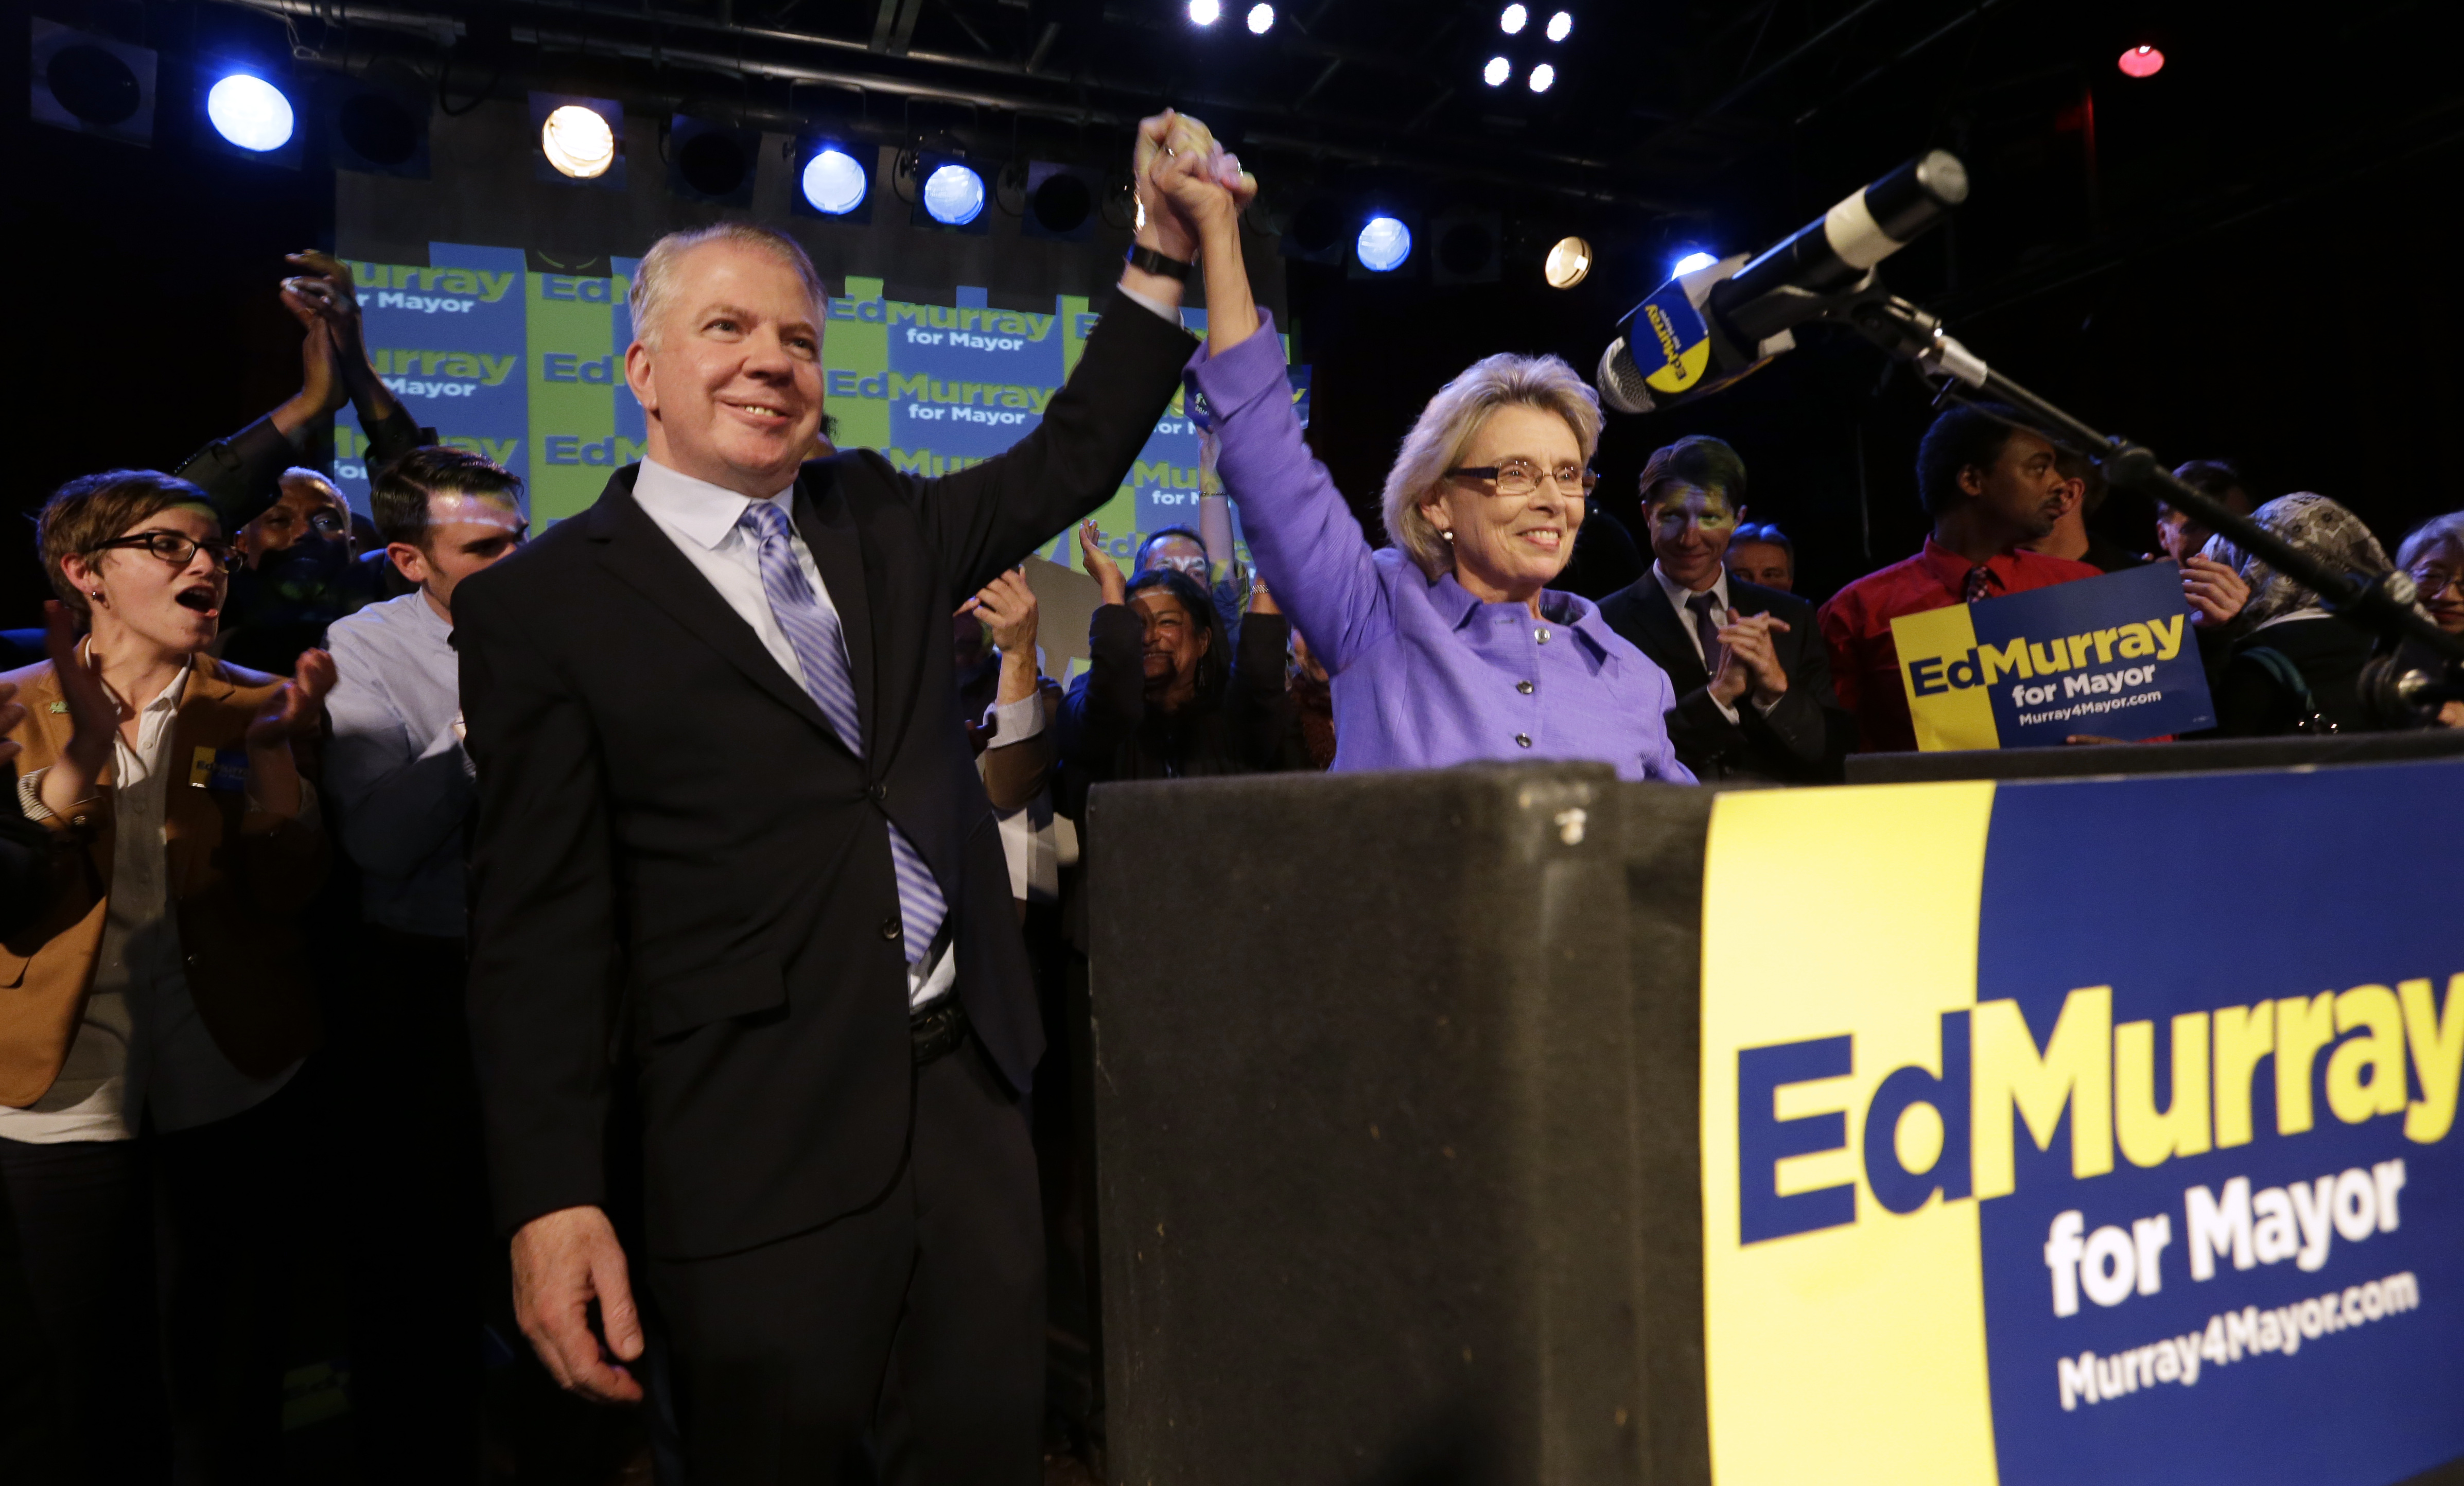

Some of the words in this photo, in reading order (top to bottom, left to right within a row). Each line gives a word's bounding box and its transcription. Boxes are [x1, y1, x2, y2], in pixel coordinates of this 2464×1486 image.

[351, 261, 514, 302] urray
[377, 291, 475, 313] Mayor
[828, 294, 1055, 341] EdMurray
[906, 328, 943, 346] for
[949, 332, 1023, 352] Mayor
[382, 377, 477, 398] Mayor
[827, 369, 1058, 415] EdMurray
[908, 404, 945, 421] for
[951, 407, 1026, 426] Mayor
[1151, 489, 1185, 505] for
[1909, 614, 2184, 697] EdMurray
[2012, 683, 2056, 708] for
[2064, 665, 2156, 698] Mayor
[2018, 690, 2162, 726] Murray4Mayor.com
[1737, 971, 2464, 1249] EdMurray
[2044, 1209, 2171, 1318] for
[2184, 1159, 2407, 1282] Mayor
[2057, 1270, 2419, 1412] Murray4Mayor.com
